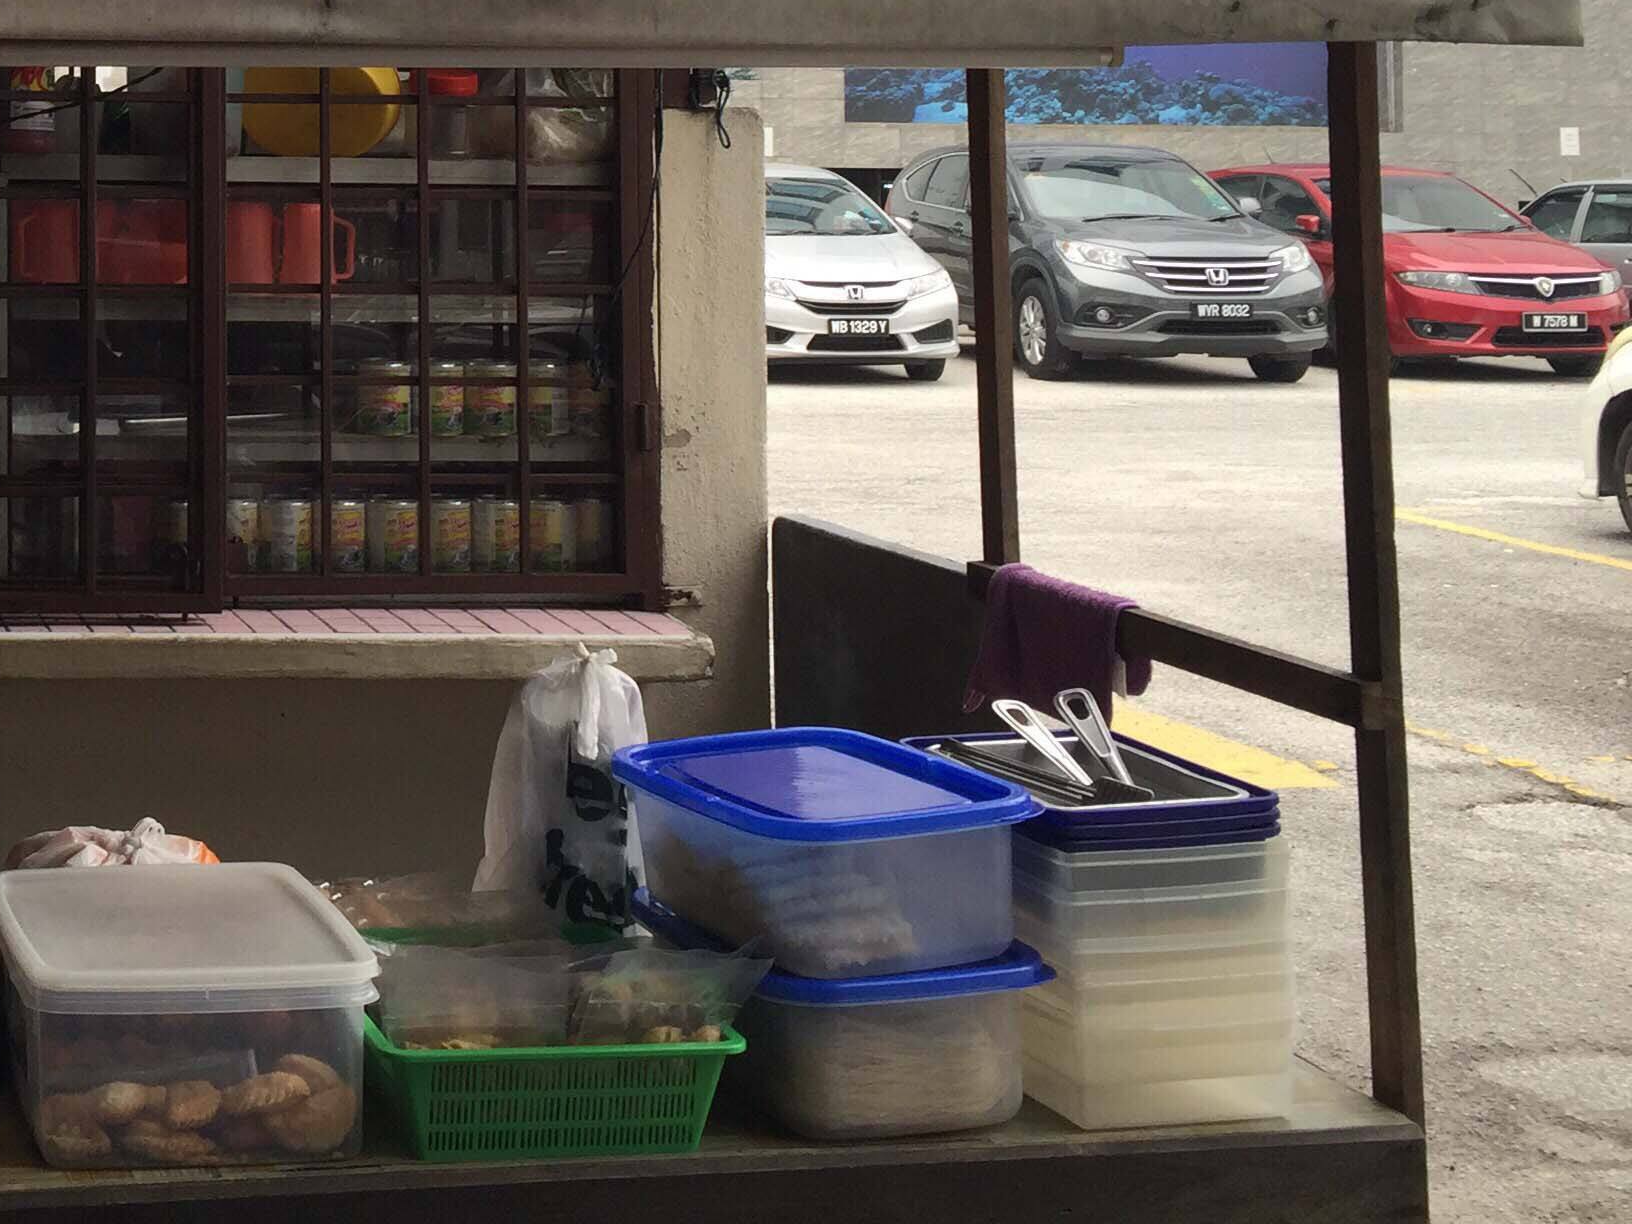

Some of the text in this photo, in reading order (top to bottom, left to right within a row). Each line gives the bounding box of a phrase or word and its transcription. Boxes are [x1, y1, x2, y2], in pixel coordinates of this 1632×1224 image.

[831, 320, 887, 334] WB 1329 Y
